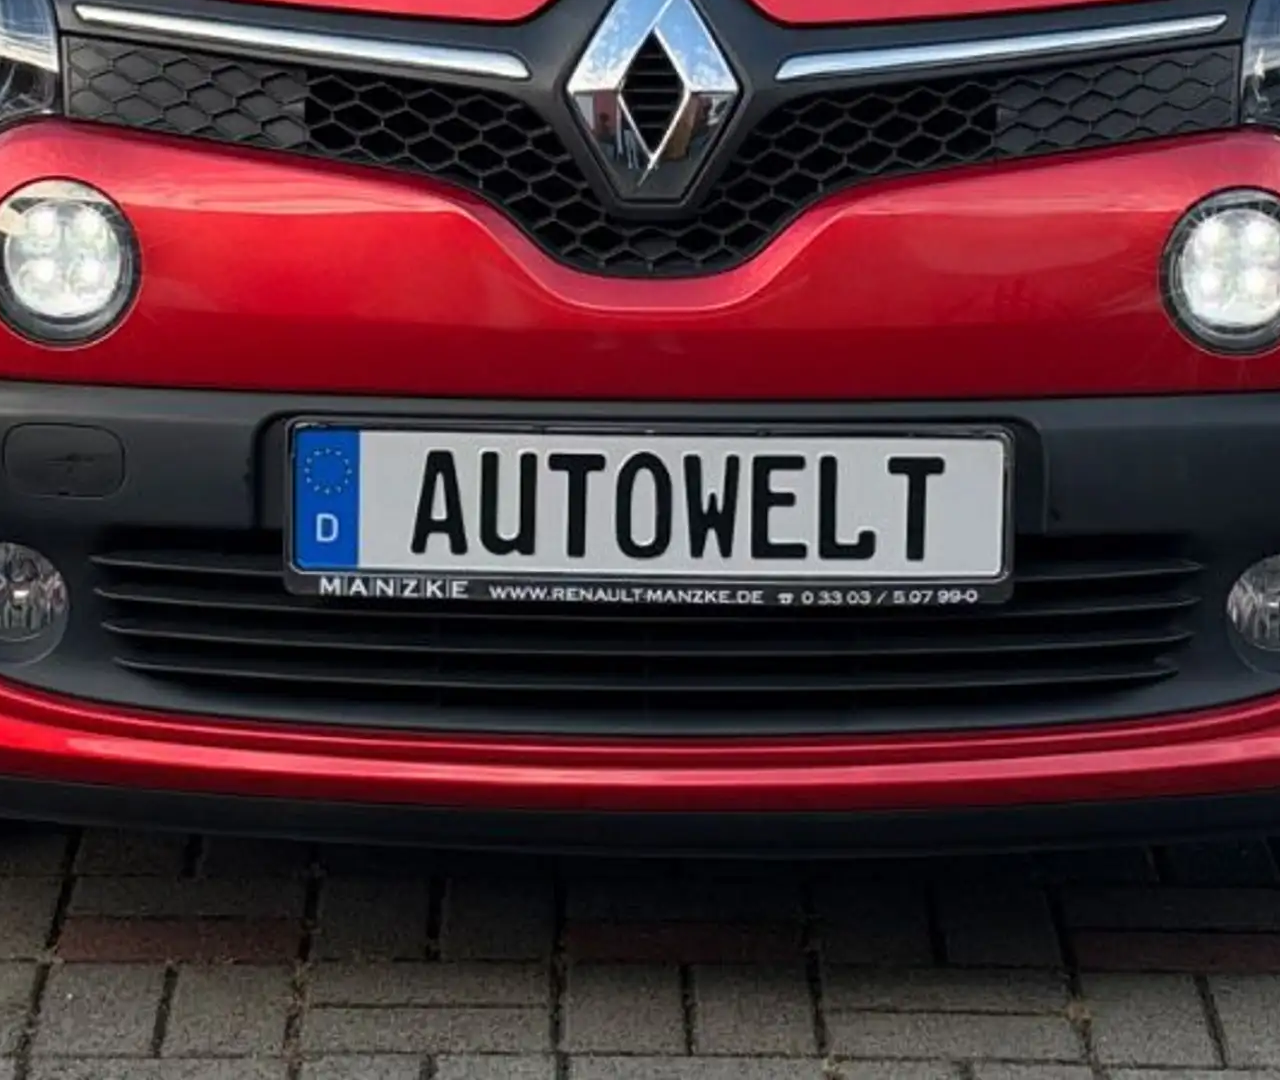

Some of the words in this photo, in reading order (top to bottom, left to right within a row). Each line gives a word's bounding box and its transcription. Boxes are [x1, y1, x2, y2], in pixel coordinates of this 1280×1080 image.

[410, 450, 946, 561] AUTOWELT
[316, 513, 339, 542] D
[320, 575, 469, 599] MANZKE
